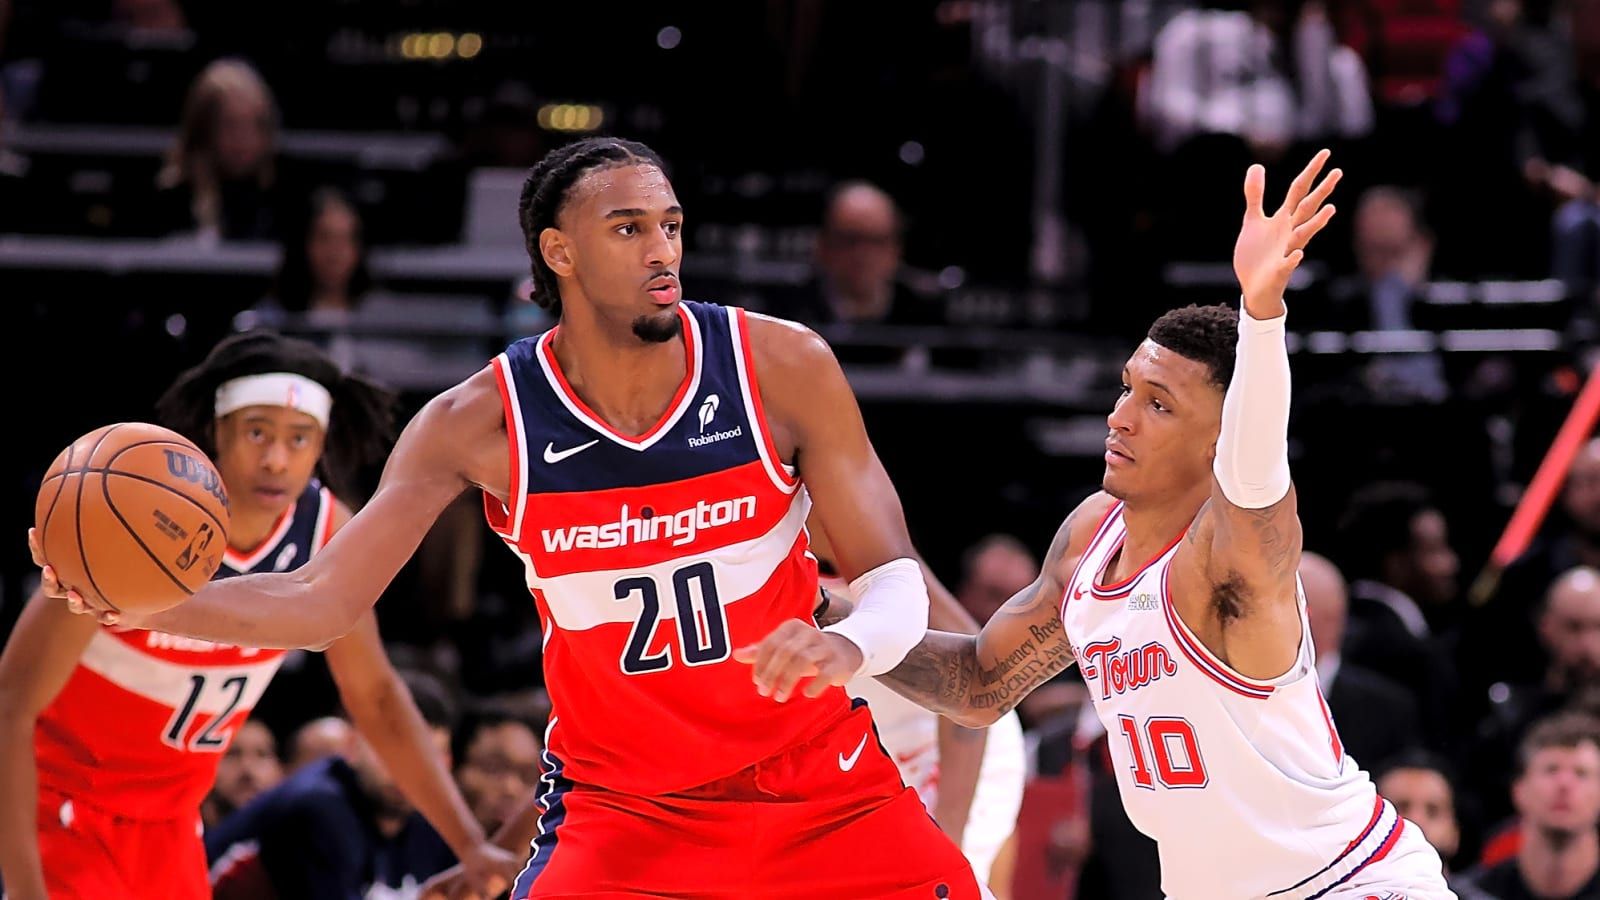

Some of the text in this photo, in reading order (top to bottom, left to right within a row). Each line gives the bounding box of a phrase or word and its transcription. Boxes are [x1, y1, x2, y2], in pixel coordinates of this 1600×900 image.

[688, 425, 742, 448] Robinhood
[541, 495, 757, 553] washington
[613, 559, 733, 676] 20
[978, 639, 1038, 687] Cplacency
[1072, 636, 1177, 700] -Town
[163, 674, 249, 749] 12
[1118, 714, 1209, 790] 10
